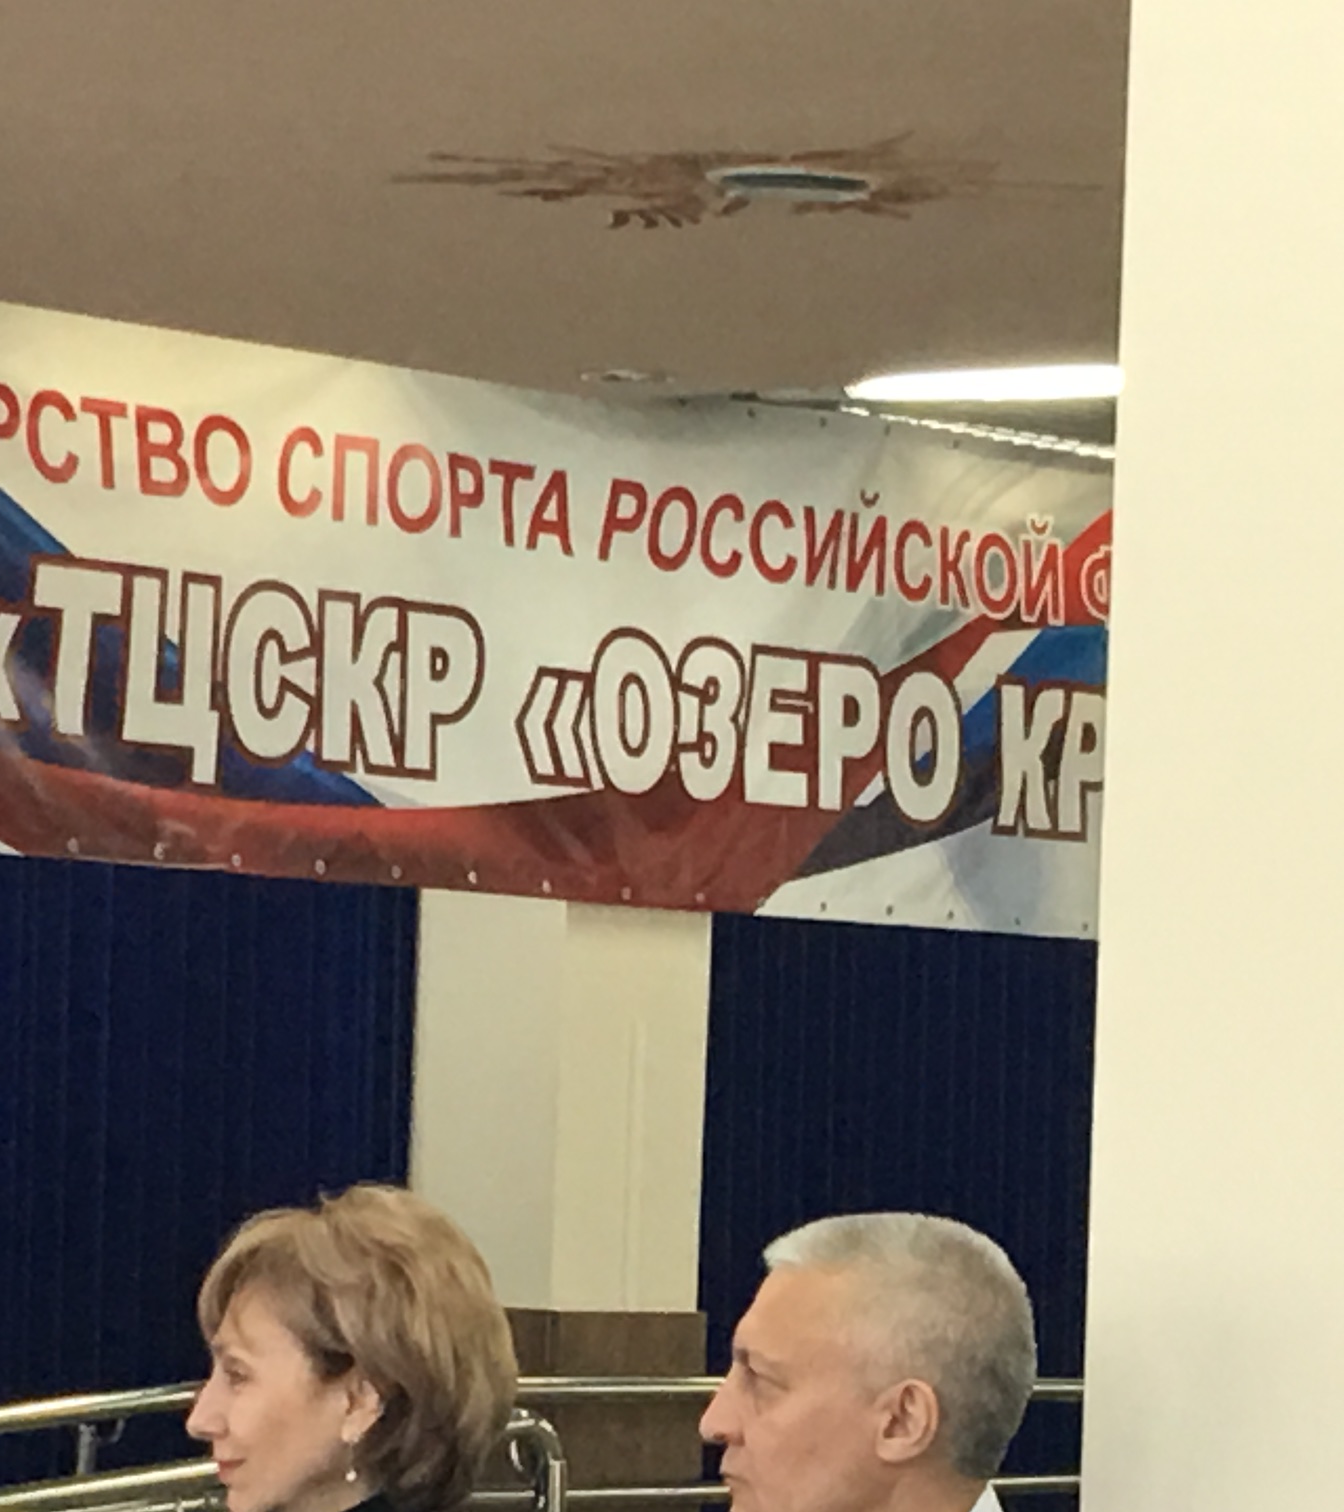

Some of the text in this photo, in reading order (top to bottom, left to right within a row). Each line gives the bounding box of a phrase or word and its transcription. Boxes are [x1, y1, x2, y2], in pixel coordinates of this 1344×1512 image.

[278, 426, 574, 557] СПОРТА
[597, 478, 1064, 626] РОССИЙСКОЙ
[515, 626, 962, 827] «ОЗЕРО
